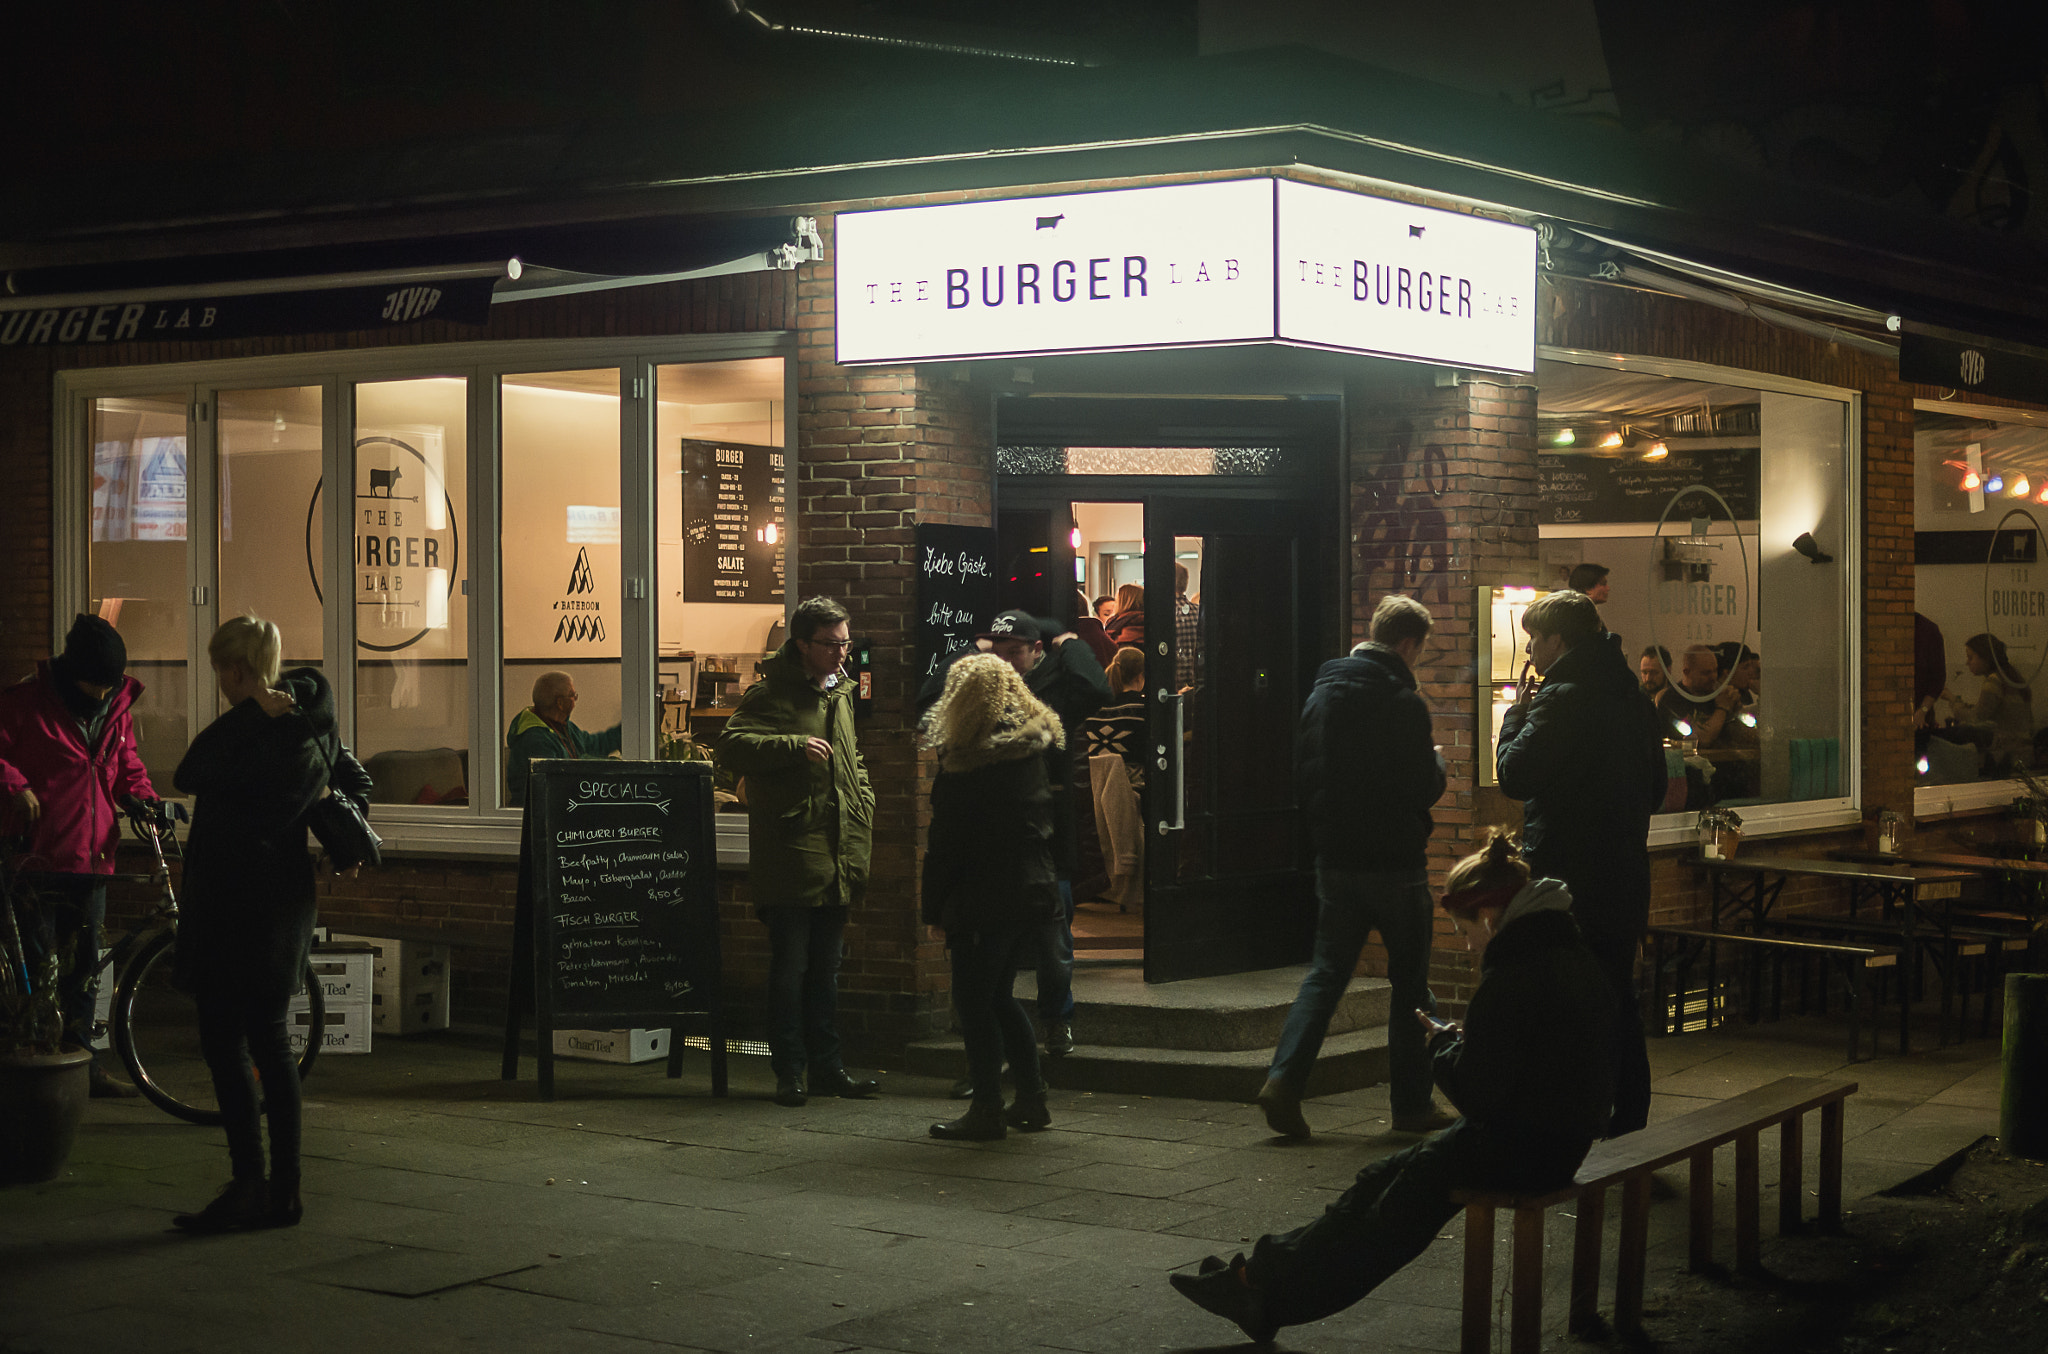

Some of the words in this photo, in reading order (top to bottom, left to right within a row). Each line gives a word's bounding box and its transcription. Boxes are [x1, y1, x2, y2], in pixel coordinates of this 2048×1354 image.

[866, 280, 929, 305] THE
[946, 255, 1149, 310] BURGER
[1168, 258, 1240, 285] LAB
[1353, 259, 1472, 319] BURGER
[381, 287, 442, 322] JEVER
[0, 304, 147, 345] URGER
[153, 306, 218, 330] LAB
[1959, 349, 1986, 385] JEVER
[715, 448, 744, 465] BURGER
[364, 509, 404, 527] THE
[717, 556, 745, 572] SALATE
[923, 545, 954, 579] Liebe
[364, 574, 404, 592] LAB
[1660, 583, 1738, 616] BURGER
[1992, 588, 2046, 617] BURGER
[925, 601, 954, 627] bitte
[579, 780, 662, 799] SPECIALS
[647, 887, 671, 902] 8,50
[552, 913, 591, 928] FISCH
[567, 1036, 612, 1053] ChariTea
